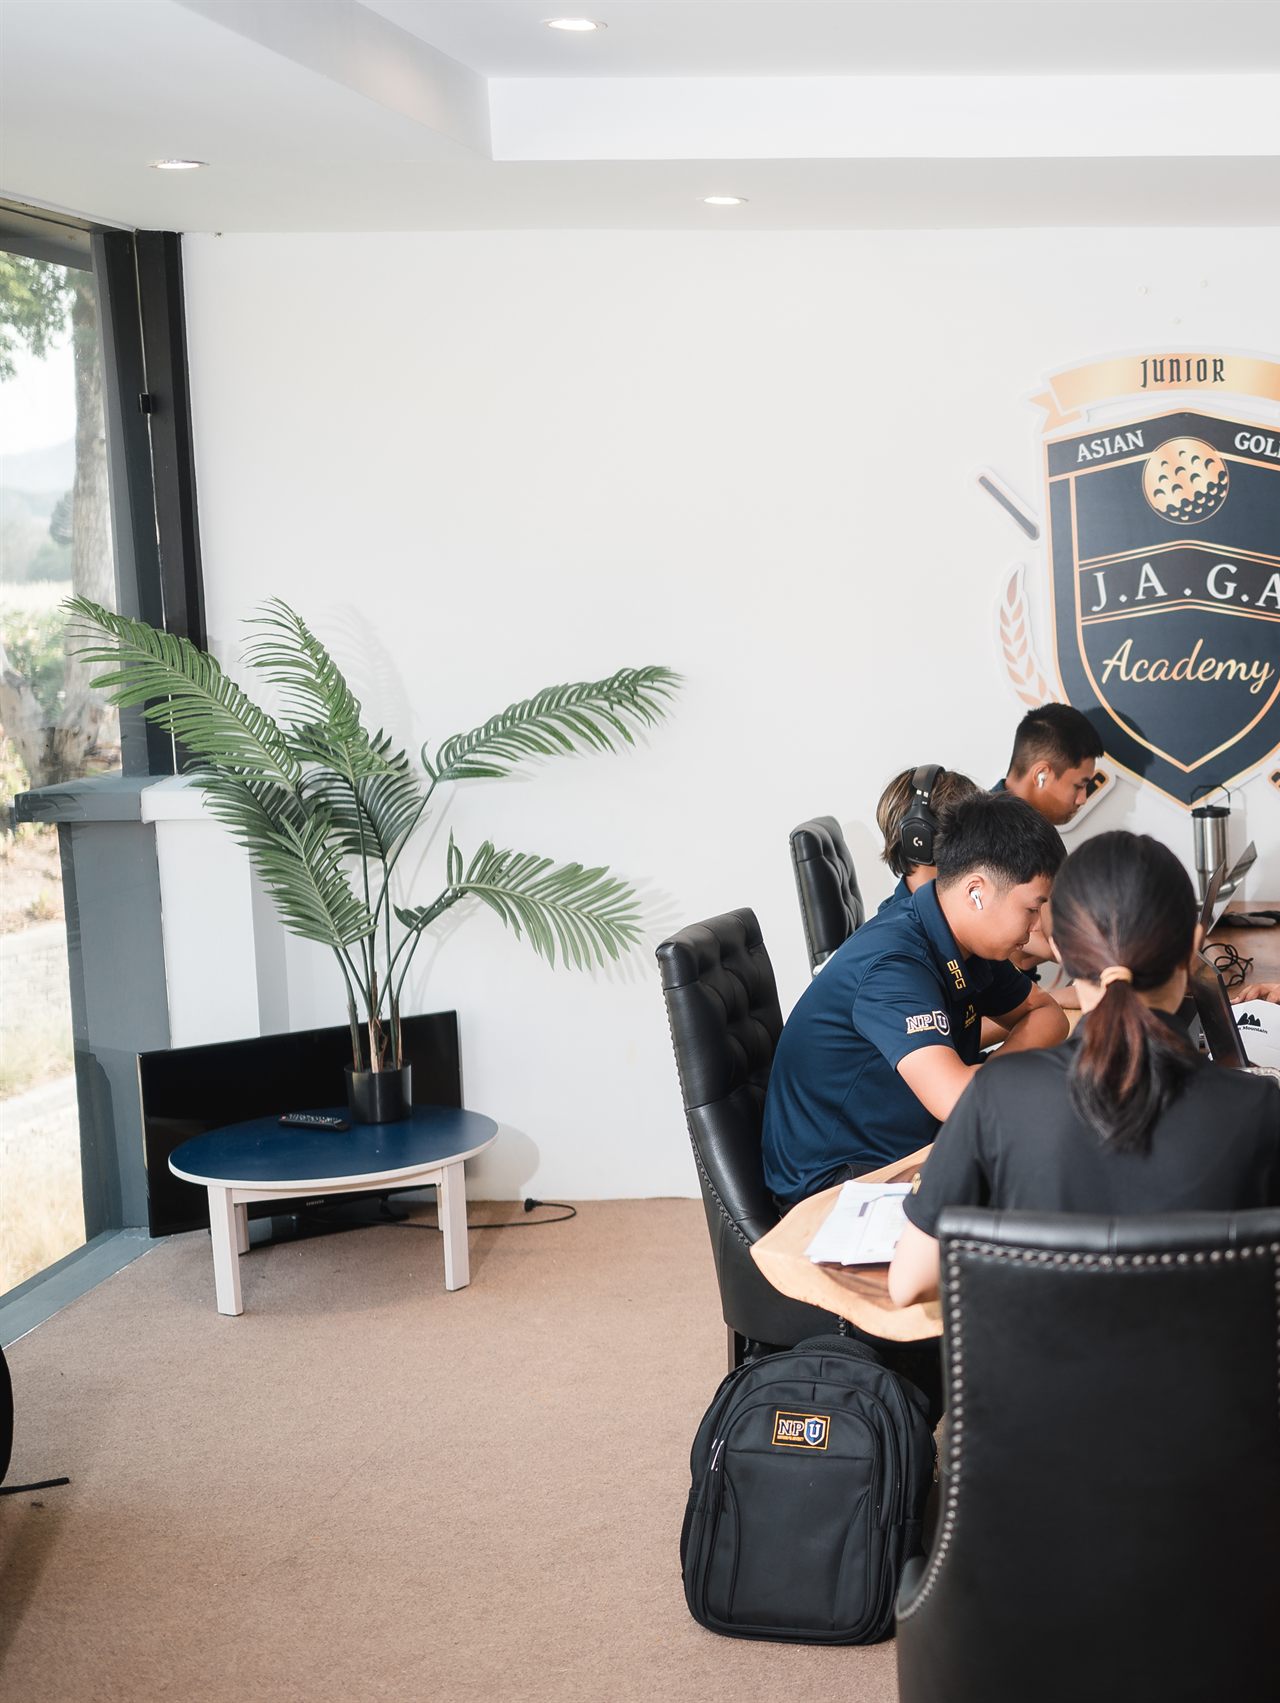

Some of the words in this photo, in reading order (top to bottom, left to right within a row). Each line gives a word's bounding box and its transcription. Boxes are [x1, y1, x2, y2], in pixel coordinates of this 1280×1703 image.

[1140, 358, 1226, 388] JUNIOR
[1076, 430, 1145, 463] ASIAN
[1101, 638, 1275, 694] Academy
